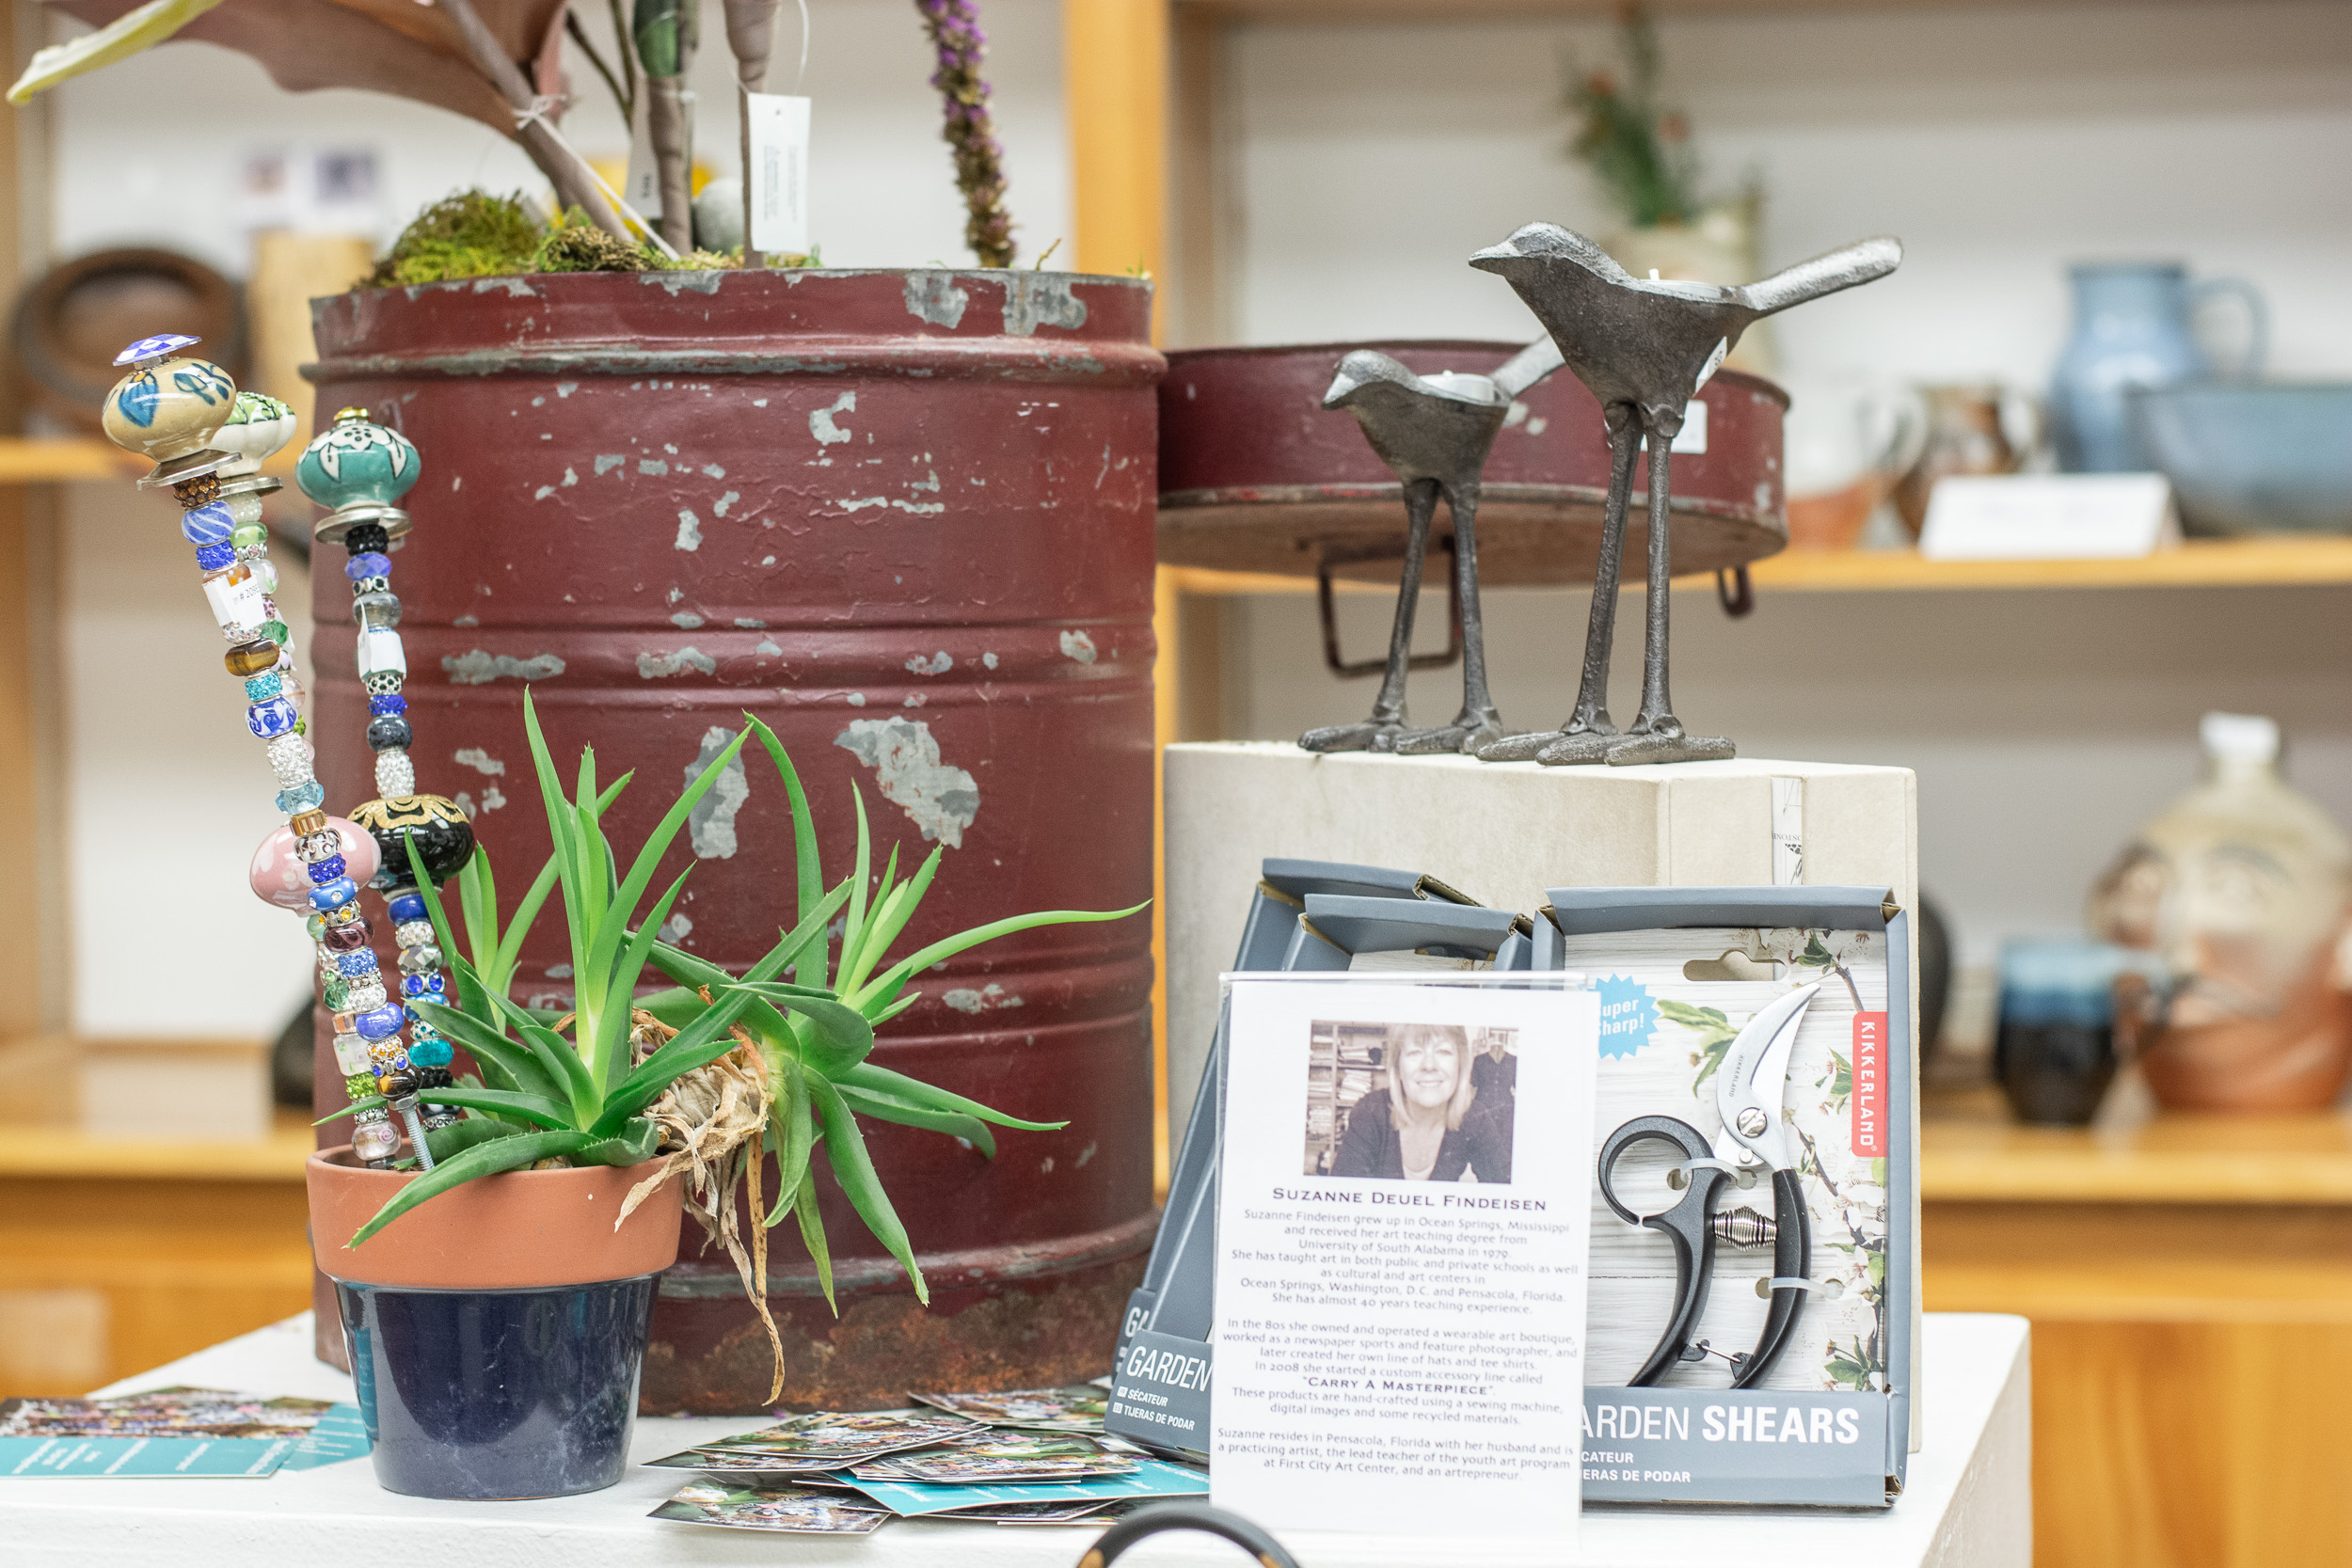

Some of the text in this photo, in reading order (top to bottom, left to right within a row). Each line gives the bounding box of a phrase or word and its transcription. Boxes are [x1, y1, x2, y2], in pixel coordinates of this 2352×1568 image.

[1601, 999, 1639, 1020] uper
[1600, 1013, 1645, 1036] harp!
[1729, 1054, 1744, 1098] KIKKERLAND
[1244, 1208, 1294, 1221] Suzanne
[1295, 1211, 1351, 1224] Findeisen
[1353, 1215, 1383, 1227] grew
[1386, 1216, 1402, 1228] up
[1404, 1215, 1416, 1227] in
[1418, 1216, 1455, 1228] Ocean
[1507, 1220, 1570, 1235] Mississippi
[1283, 1225, 1528, 1245] and received her art teaching degree from
[1298, 1239, 1359, 1254] University
[1360, 1241, 1375, 1252] of
[1376, 1242, 1411, 1254] South
[1413, 1243, 1465, 1257] Alabama
[1467, 1246, 1480, 1257] in
[1232, 1248, 1579, 1275] She has taught art in both public and private schools as well
[1240, 1276, 1277, 1290] Ocean
[1432, 1286, 1455, 1298] and
[1320, 1268, 1486, 1285] as cultural and art centers in
[1272, 1291, 1293, 1304] She
[1295, 1292, 1316, 1305] has
[1317, 1293, 1358, 1307] almost
[1360, 1298, 1376, 1308] 40
[1379, 1299, 1410, 1310] years
[1412, 1299, 1464, 1314] teaching
[1227, 1318, 1239, 1329] In
[1242, 1318, 1262, 1330] the
[1264, 1320, 1286, 1331] 80s
[1288, 1320, 1309, 1332] she
[1311, 1323, 1350, 1334] owned
[1352, 1323, 1375, 1336] and
[1376, 1326, 1430, 1338] operated
[1432, 1329, 1439, 1338] a
[1442, 1329, 1496, 1340] wearable
[1498, 1332, 1517, 1342] art
[1222, 1331, 1266, 1343] worked
[1268, 1335, 1281, 1344] as
[1283, 1336, 1292, 1345] a
[1294, 1336, 1357, 1350] newspaper
[1359, 1339, 1395, 1351] sports
[1397, 1339, 1420, 1351] and
[1422, 1339, 1466, 1353] feature
[1555, 1347, 1578, 1358] and
[1126, 1345, 1213, 1392] GARDEN
[1260, 1346, 1287, 1358] later
[1289, 1349, 1333, 1360] created
[1336, 1350, 1356, 1362] her
[1358, 1354, 1384, 1363] own
[1387, 1352, 1409, 1364] line
[1411, 1354, 1425, 1365] of
[1427, 1354, 1453, 1366] hats
[1454, 1356, 1477, 1368] and
[1480, 1358, 1500, 1369] tee
[1254, 1360, 1544, 1385] In 2008 she started a custom accessory line called
[1364, 1379, 1375, 1390] A
[1127, 1387, 1168, 1407] SÉCATEUR
[1232, 1386, 1266, 1399] These
[1267, 1389, 1319, 1402] products
[1322, 1393, 1341, 1402] are
[1343, 1391, 1419, 1406] hand-crafted
[1422, 1397, 1454, 1411] using
[1455, 1400, 1463, 1408] a
[1466, 1400, 1507, 1413] sewing
[1124, 1404, 1155, 1422] TIJERAS
[1155, 1413, 1167, 1424] DE
[1167, 1415, 1196, 1431] PODAR
[1269, 1402, 1308, 1416] digital
[1310, 1404, 1351, 1418] images
[1353, 1406, 1375, 1418] and
[1378, 1409, 1410, 1420] some
[1412, 1410, 1461, 1423] recycled
[1582, 1404, 1859, 1444] ARDEN SHEARS
[1217, 1427, 1266, 1440] Suzanne
[1268, 1431, 1309, 1442] resides
[1311, 1432, 1324, 1443] in
[1390, 1435, 1431, 1449] Florida
[1434, 1438, 1461, 1449] with
[1464, 1439, 1484, 1451] her
[1486, 1440, 1536, 1454] husband
[1539, 1444, 1562, 1455] and
[1564, 1446, 1574, 1456] is
[1217, 1443, 1225, 1451] a
[1228, 1443, 1286, 1458] practicing
[1326, 1447, 1346, 1458] the
[1348, 1448, 1374, 1460] lead
[1376, 1450, 1421, 1462] teacher
[1422, 1451, 1437, 1463] of
[1438, 1452, 1459, 1464] the
[1461, 1454, 1497, 1466] youth
[1499, 1457, 1517, 1466] art
[1519, 1458, 1571, 1471] program
[1263, 1459, 1275, 1468] at
[1279, 1457, 1305, 1470] First
[1308, 1459, 1332, 1473] City
[1334, 1461, 1354, 1472] Art
[1402, 1465, 1424, 1476] and
[1426, 1467, 1441, 1477] an
[1581, 1451, 1633, 1464] CATEUR
[1582, 1468, 1692, 1483] ERAS DE PODAR
